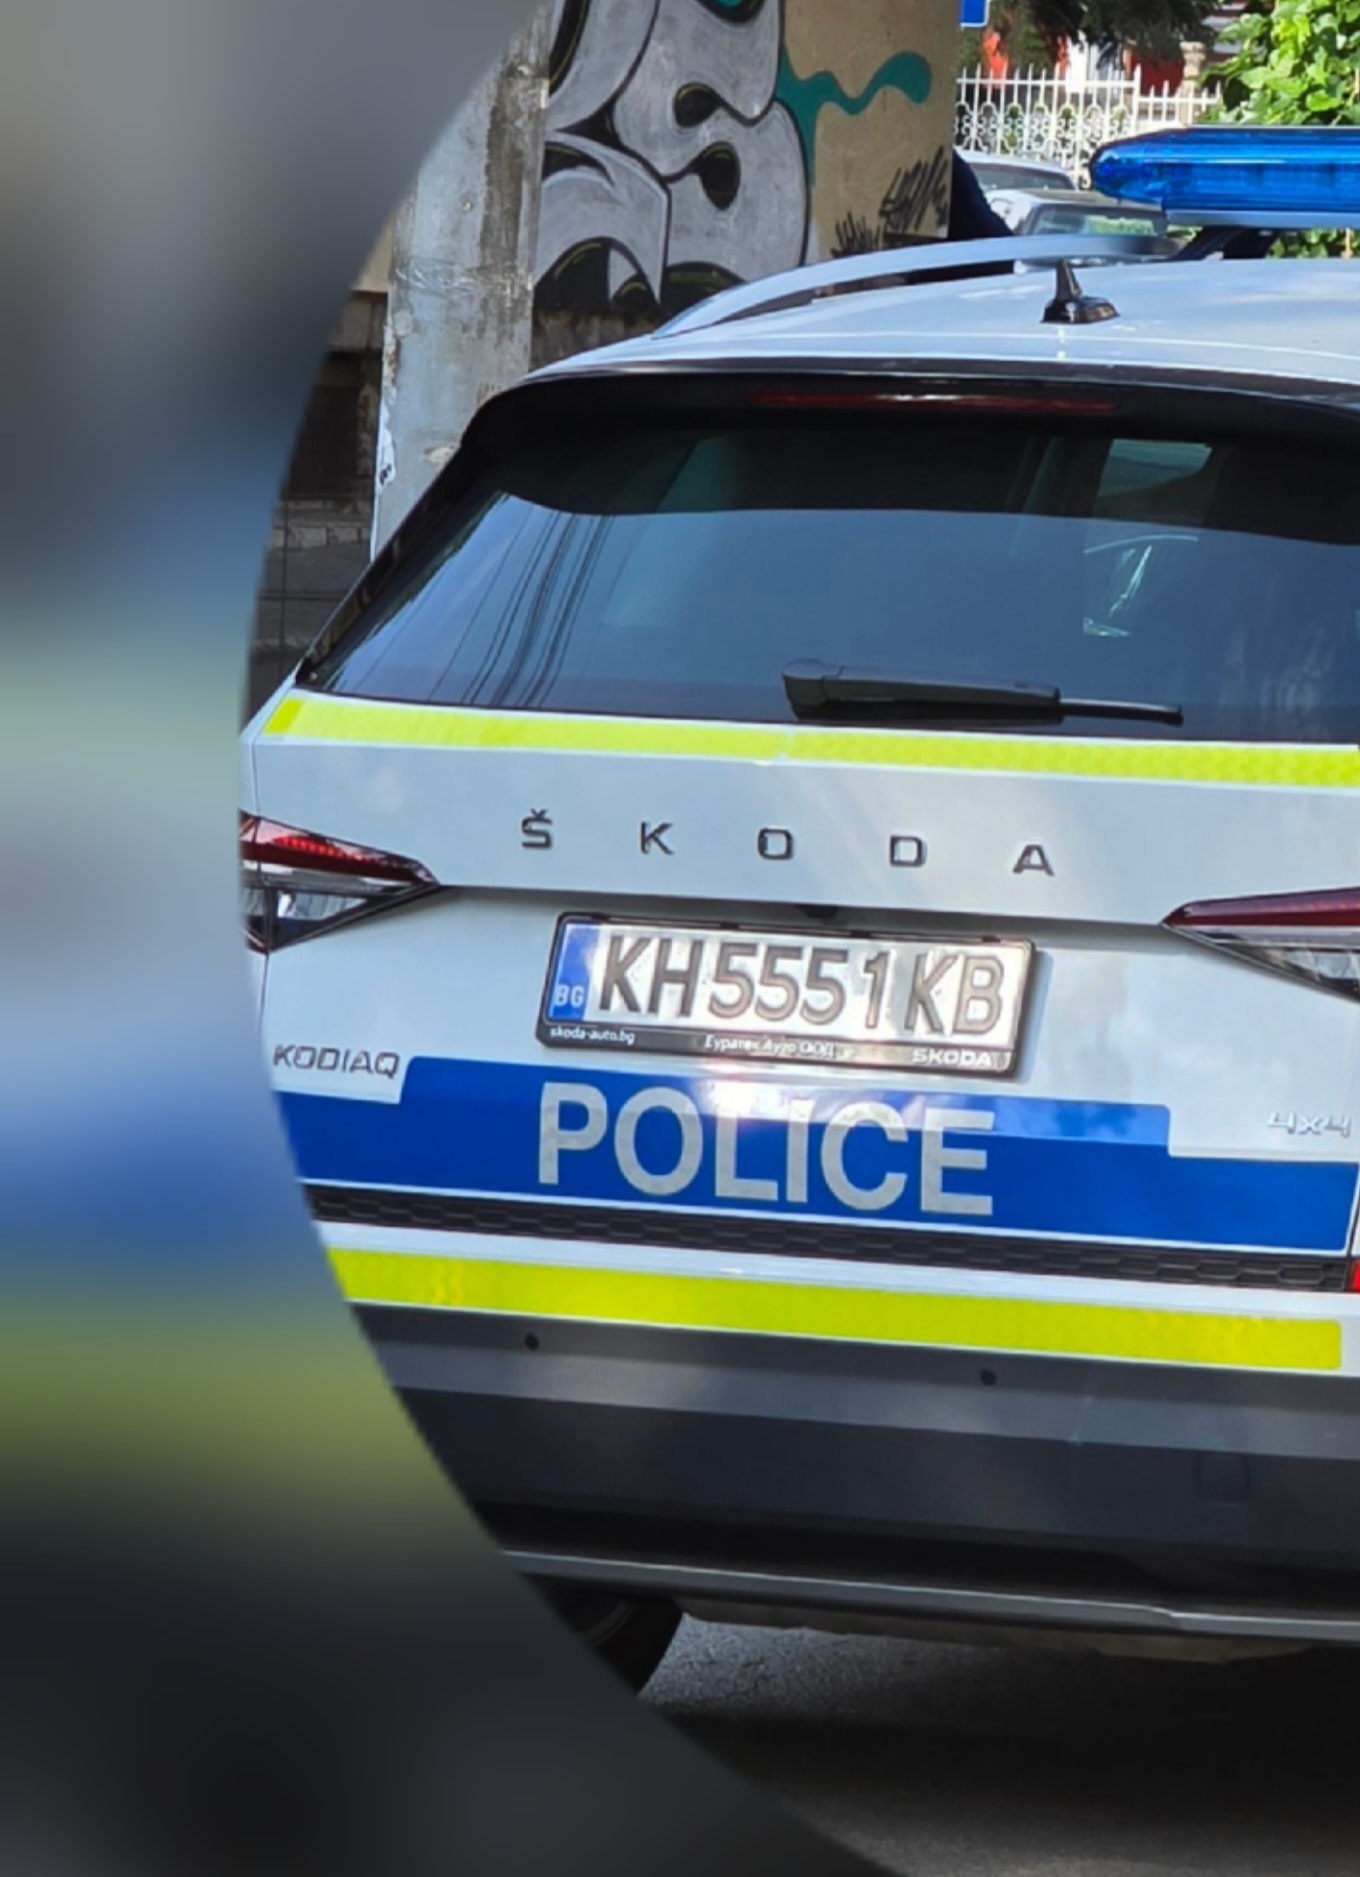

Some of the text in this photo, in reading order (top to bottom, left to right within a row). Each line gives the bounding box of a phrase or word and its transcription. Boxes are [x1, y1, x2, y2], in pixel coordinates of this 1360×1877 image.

[520, 809, 1055, 876] ŠKODA
[554, 984, 584, 1007] BG
[273, 1045, 400, 1079] KODIAQ
[538, 1081, 994, 1216] POLICE
